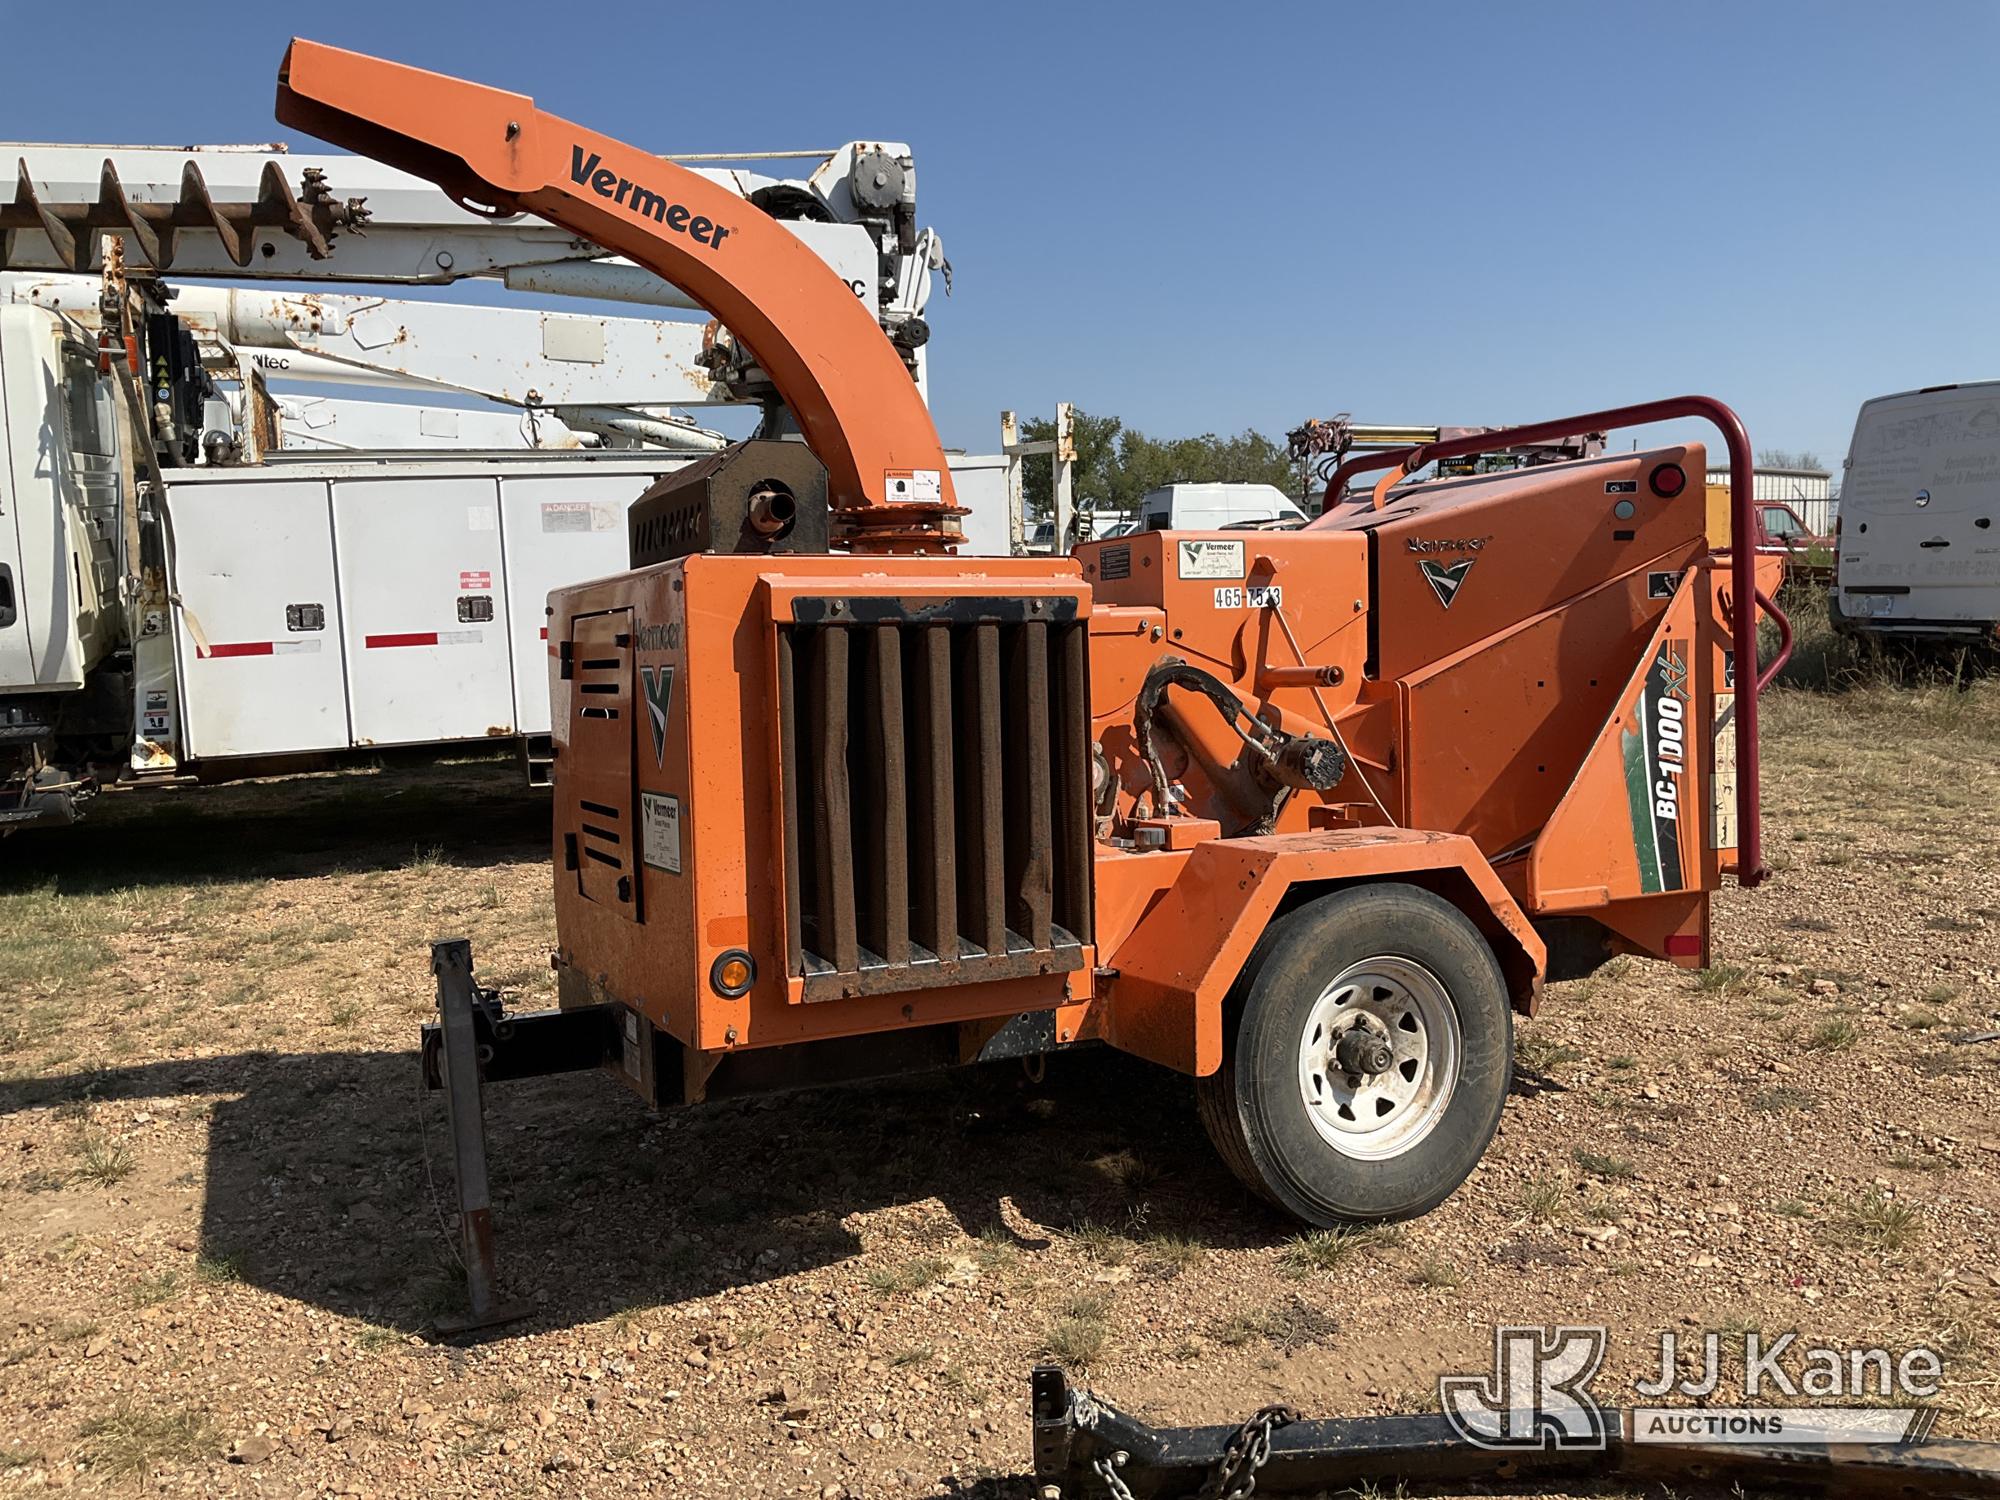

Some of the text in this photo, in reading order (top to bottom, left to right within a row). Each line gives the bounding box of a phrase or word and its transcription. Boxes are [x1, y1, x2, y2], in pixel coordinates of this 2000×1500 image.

[571, 144, 730, 250] Vermeer
[553, 503, 587, 512] DANGER
[1206, 543, 1235, 551] Vermeer
